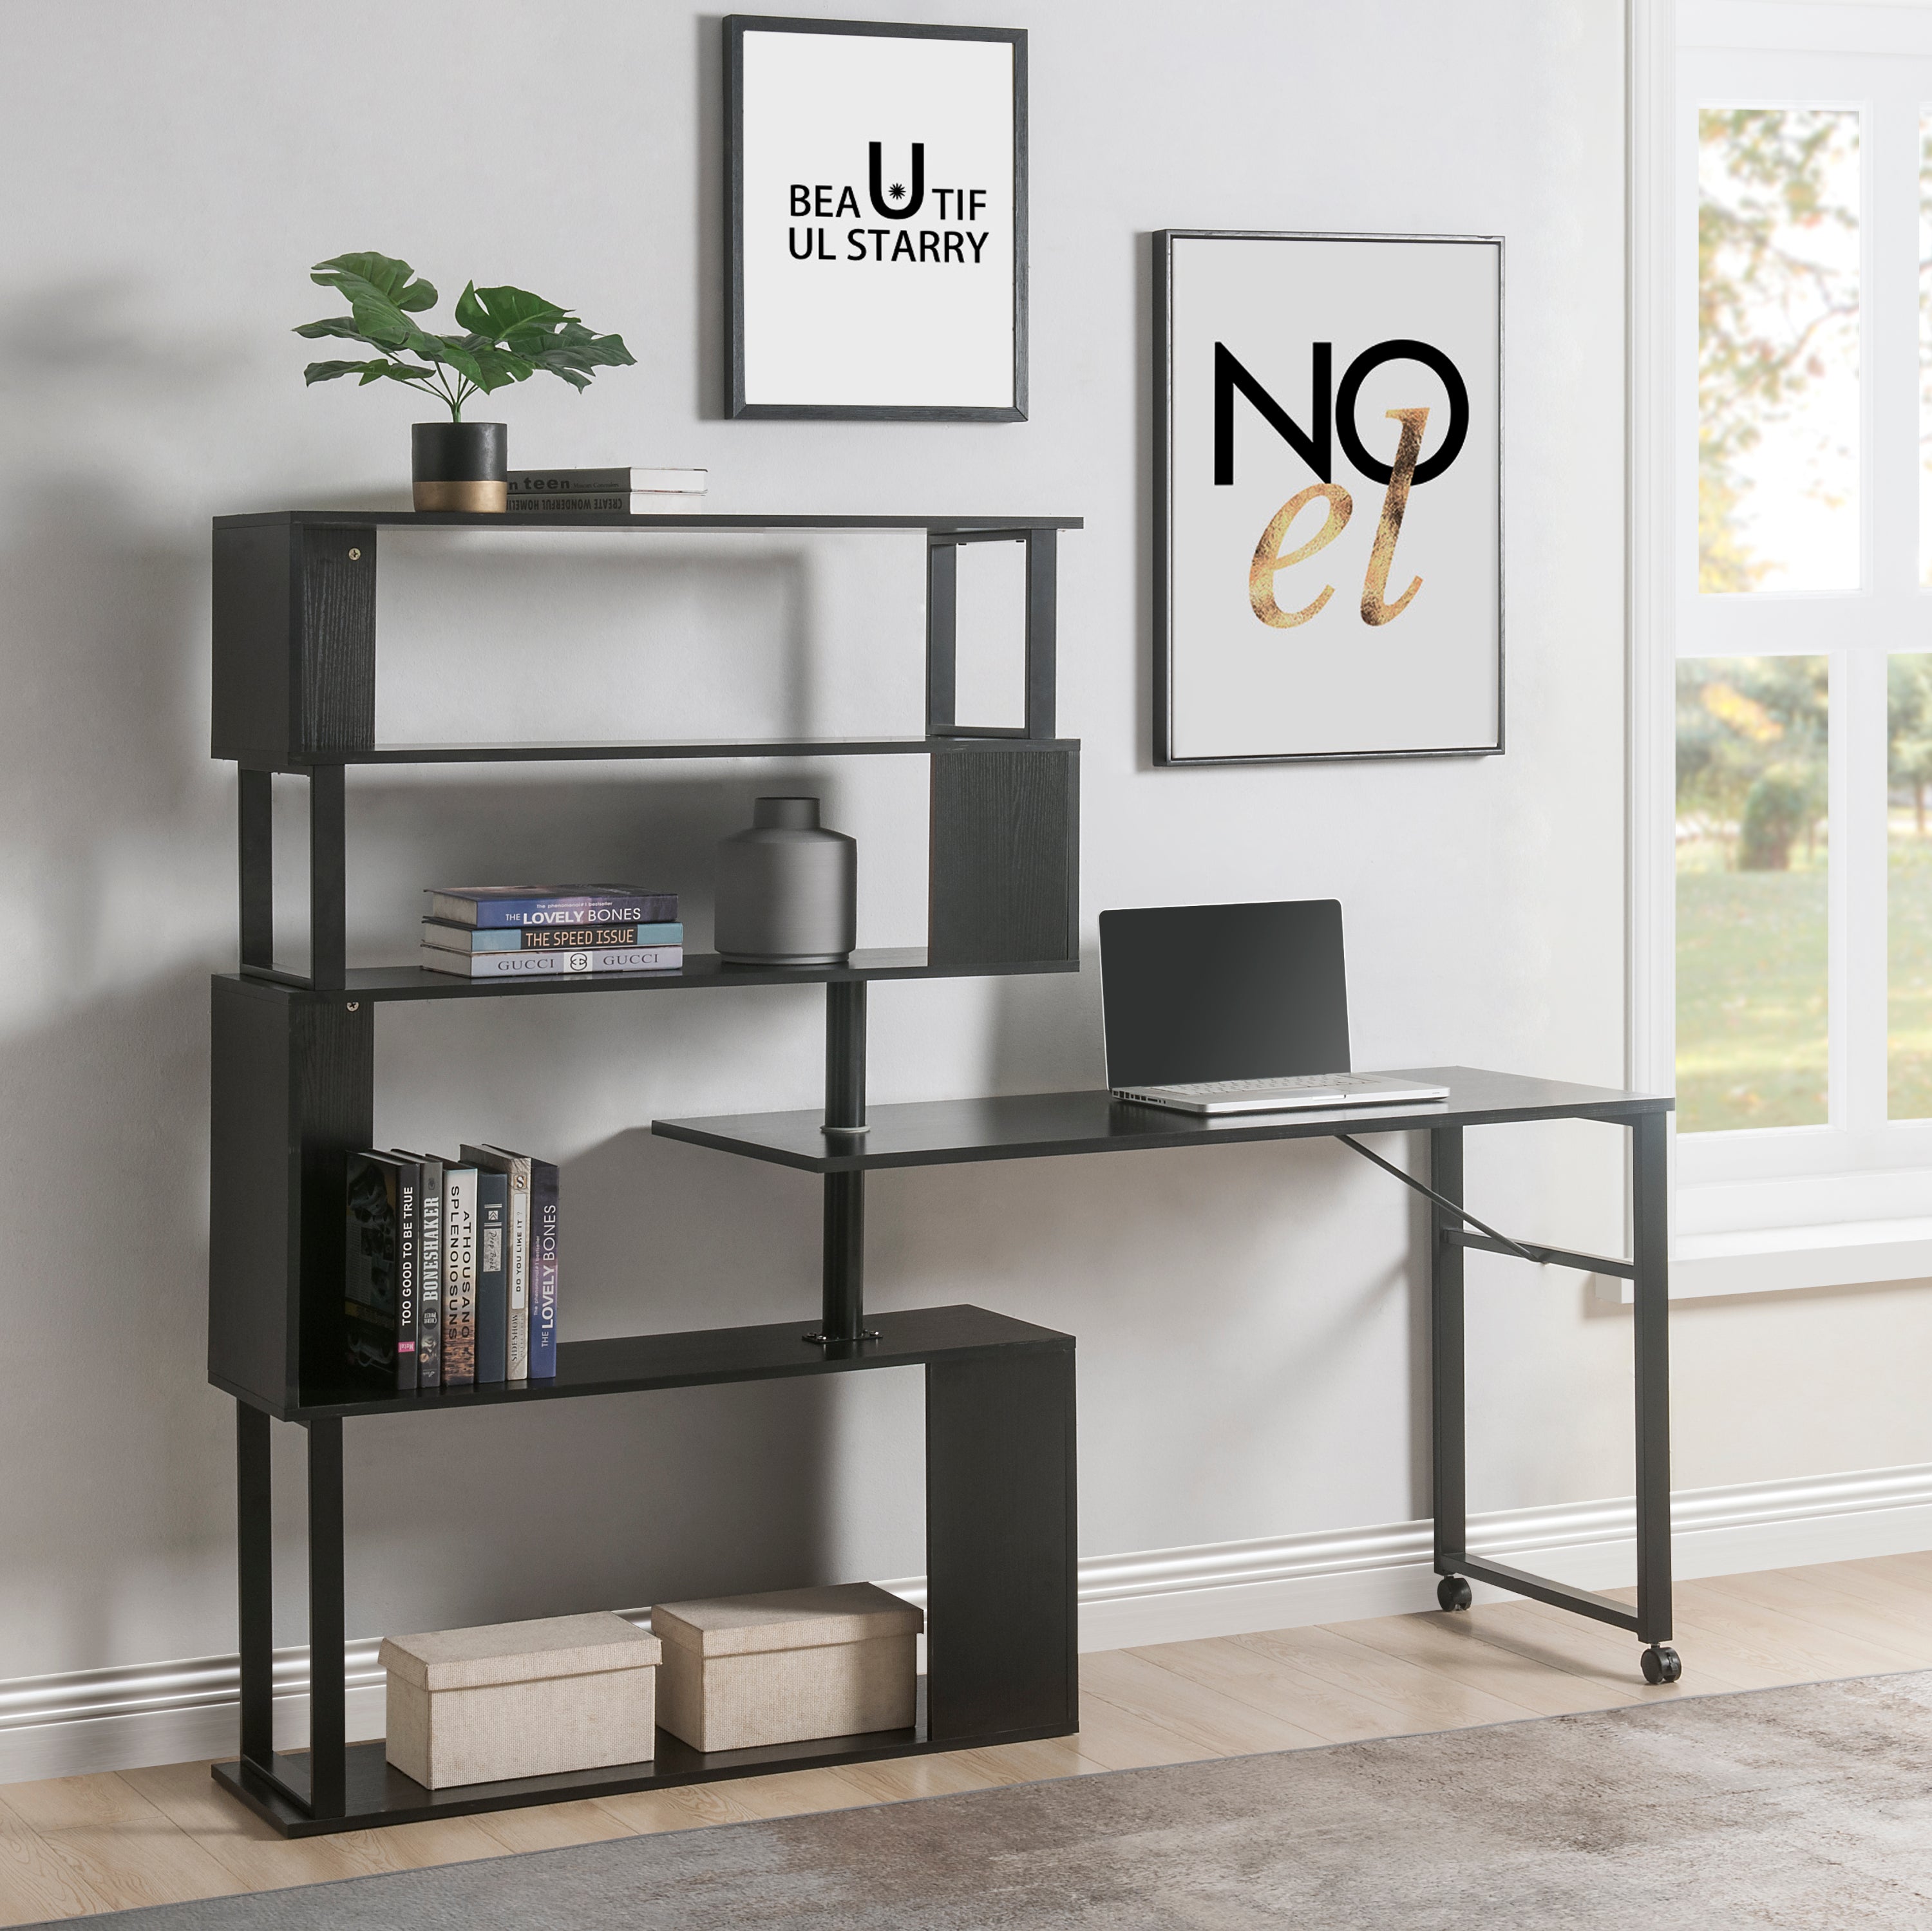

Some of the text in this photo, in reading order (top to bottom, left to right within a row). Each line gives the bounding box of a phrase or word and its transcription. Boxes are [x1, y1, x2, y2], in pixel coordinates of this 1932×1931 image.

[789, 227, 989, 263] UL STARRY
[1214, 339, 1470, 487] NO
[524, 476, 570, 490] teen
[542, 499, 591, 510] WONDERFUL
[594, 498, 623, 510] CREATE
[1248, 407, 1430, 629] el
[506, 908, 641, 925] THE LOVELY BONES
[526, 928, 634, 947] THE SPEED ISSUE
[497, 954, 659, 971] GUCCI GUCCI
[517, 1220, 522, 1228] IT
[543, 1205, 556, 1260] BONES
[402, 1187, 413, 1326] TOO GOOD TO BE TRUE
[423, 1196, 439, 1301] BONESHAKER
[516, 1278, 521, 1292] DO
[542, 1265, 555, 1328] LOVELY
